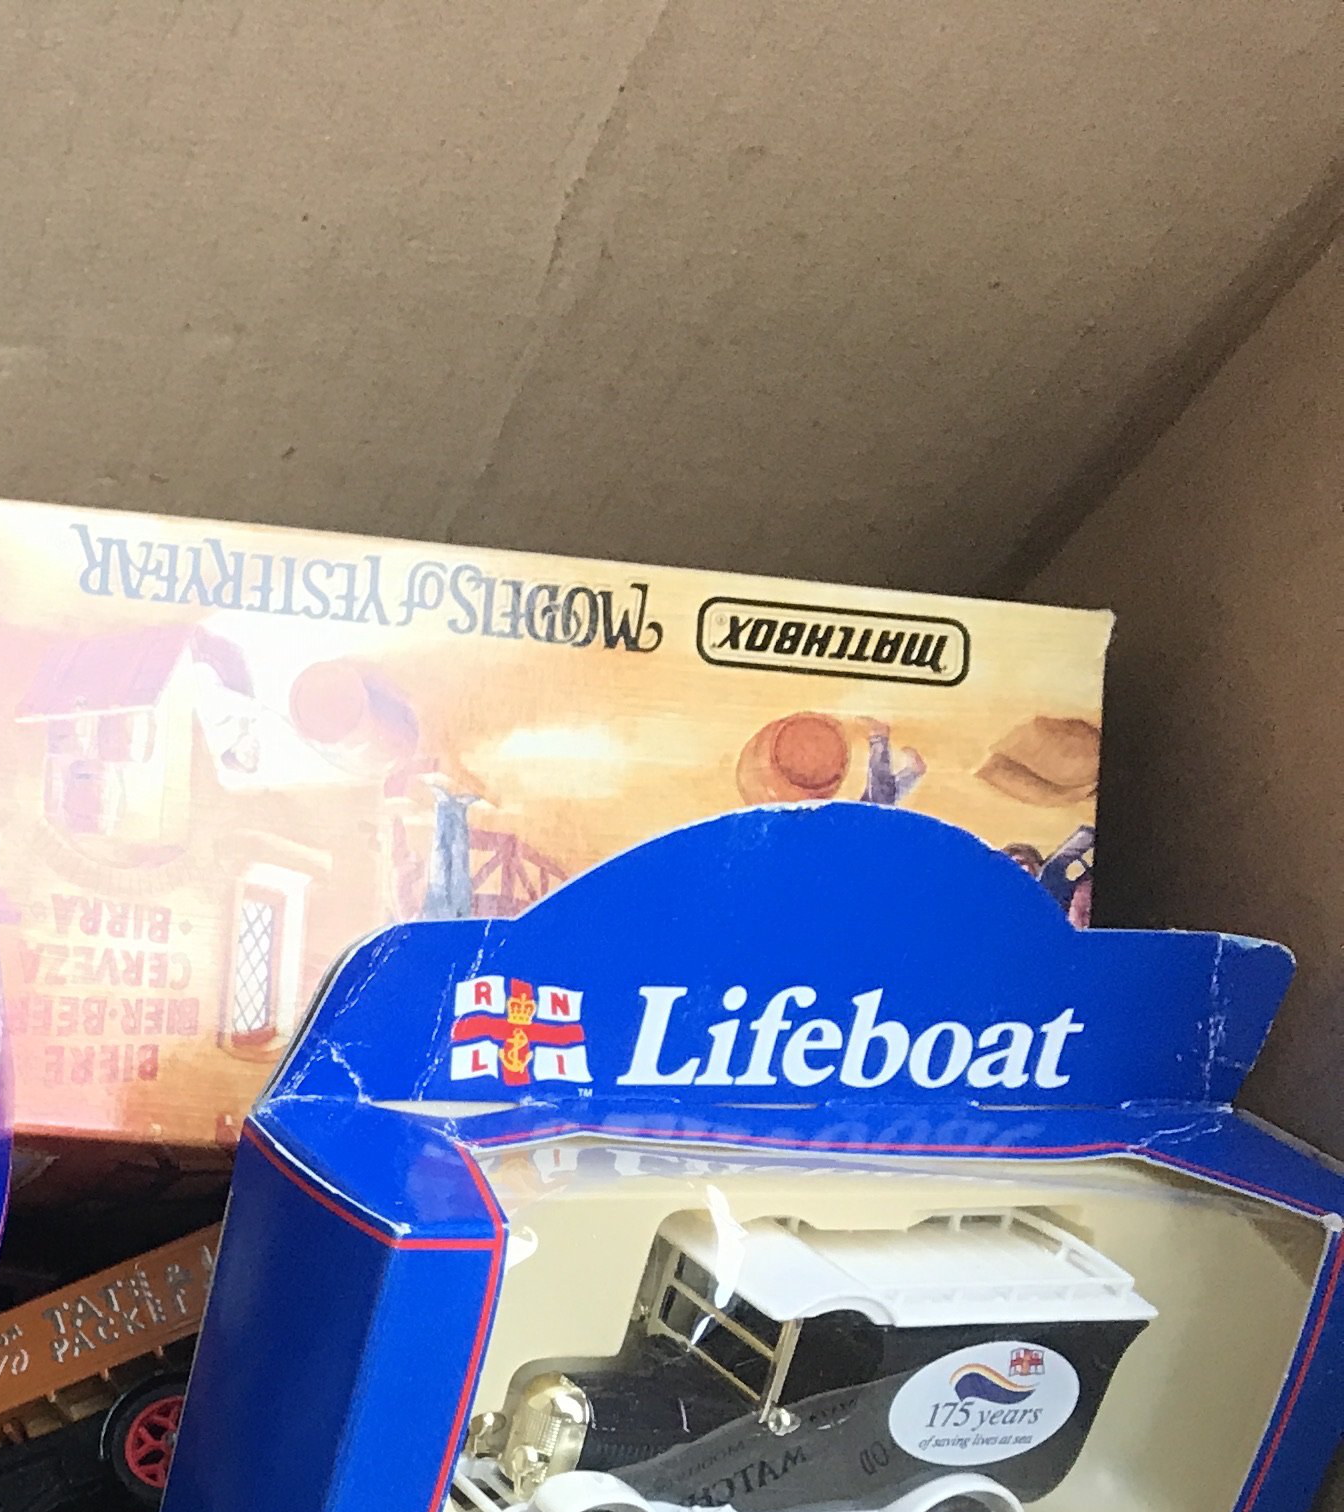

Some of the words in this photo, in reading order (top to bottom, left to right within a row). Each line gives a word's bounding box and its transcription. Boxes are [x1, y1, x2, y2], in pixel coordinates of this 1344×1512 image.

[70, 523, 391, 627] YESTERYEAR
[712, 611, 949, 673] MATCHBOX
[53, 894, 172, 943] BIRRA
[616, 986, 1086, 1089] Lifeboat
[45, 1043, 159, 1084] BIERE
[925, 1401, 976, 1429] 175
[971, 1407, 1044, 1432] years
[918, 1435, 933, 1451] of
